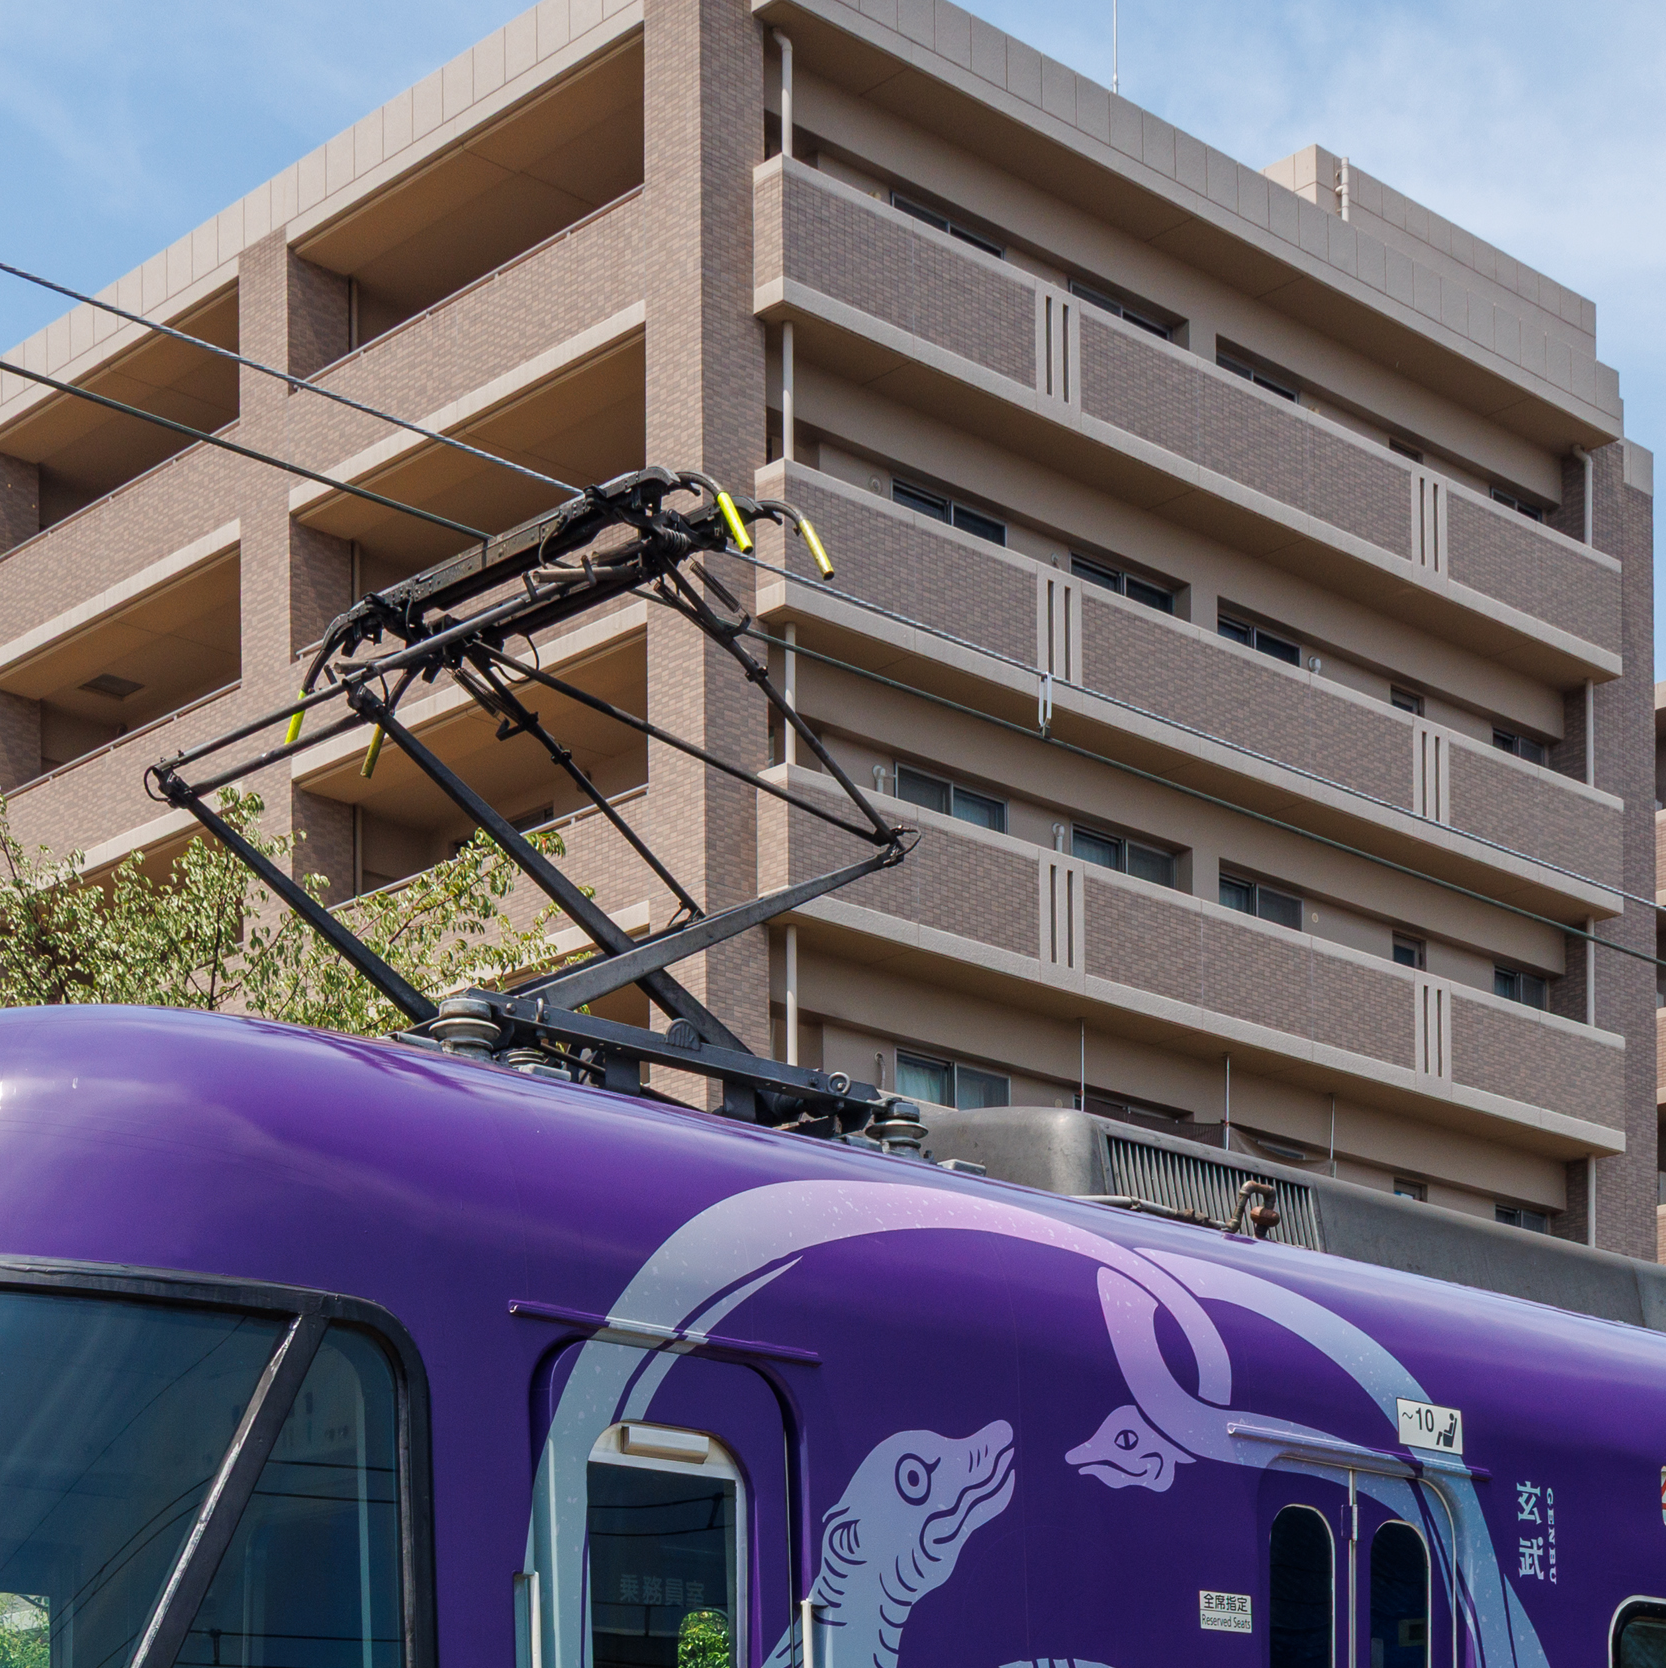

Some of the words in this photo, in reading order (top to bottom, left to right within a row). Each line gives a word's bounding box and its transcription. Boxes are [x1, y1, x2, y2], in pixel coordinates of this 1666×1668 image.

[1516, 1480, 1545, 1580] 玄武
[1546, 1487, 1557, 1585] GENBU
[620, 1573, 705, 1607] 乗務員室
[1203, 1593, 1248, 1612] 全席指定
[1201, 1613, 1232, 1628] Reserved
[1233, 1616, 1251, 1630] Seats
